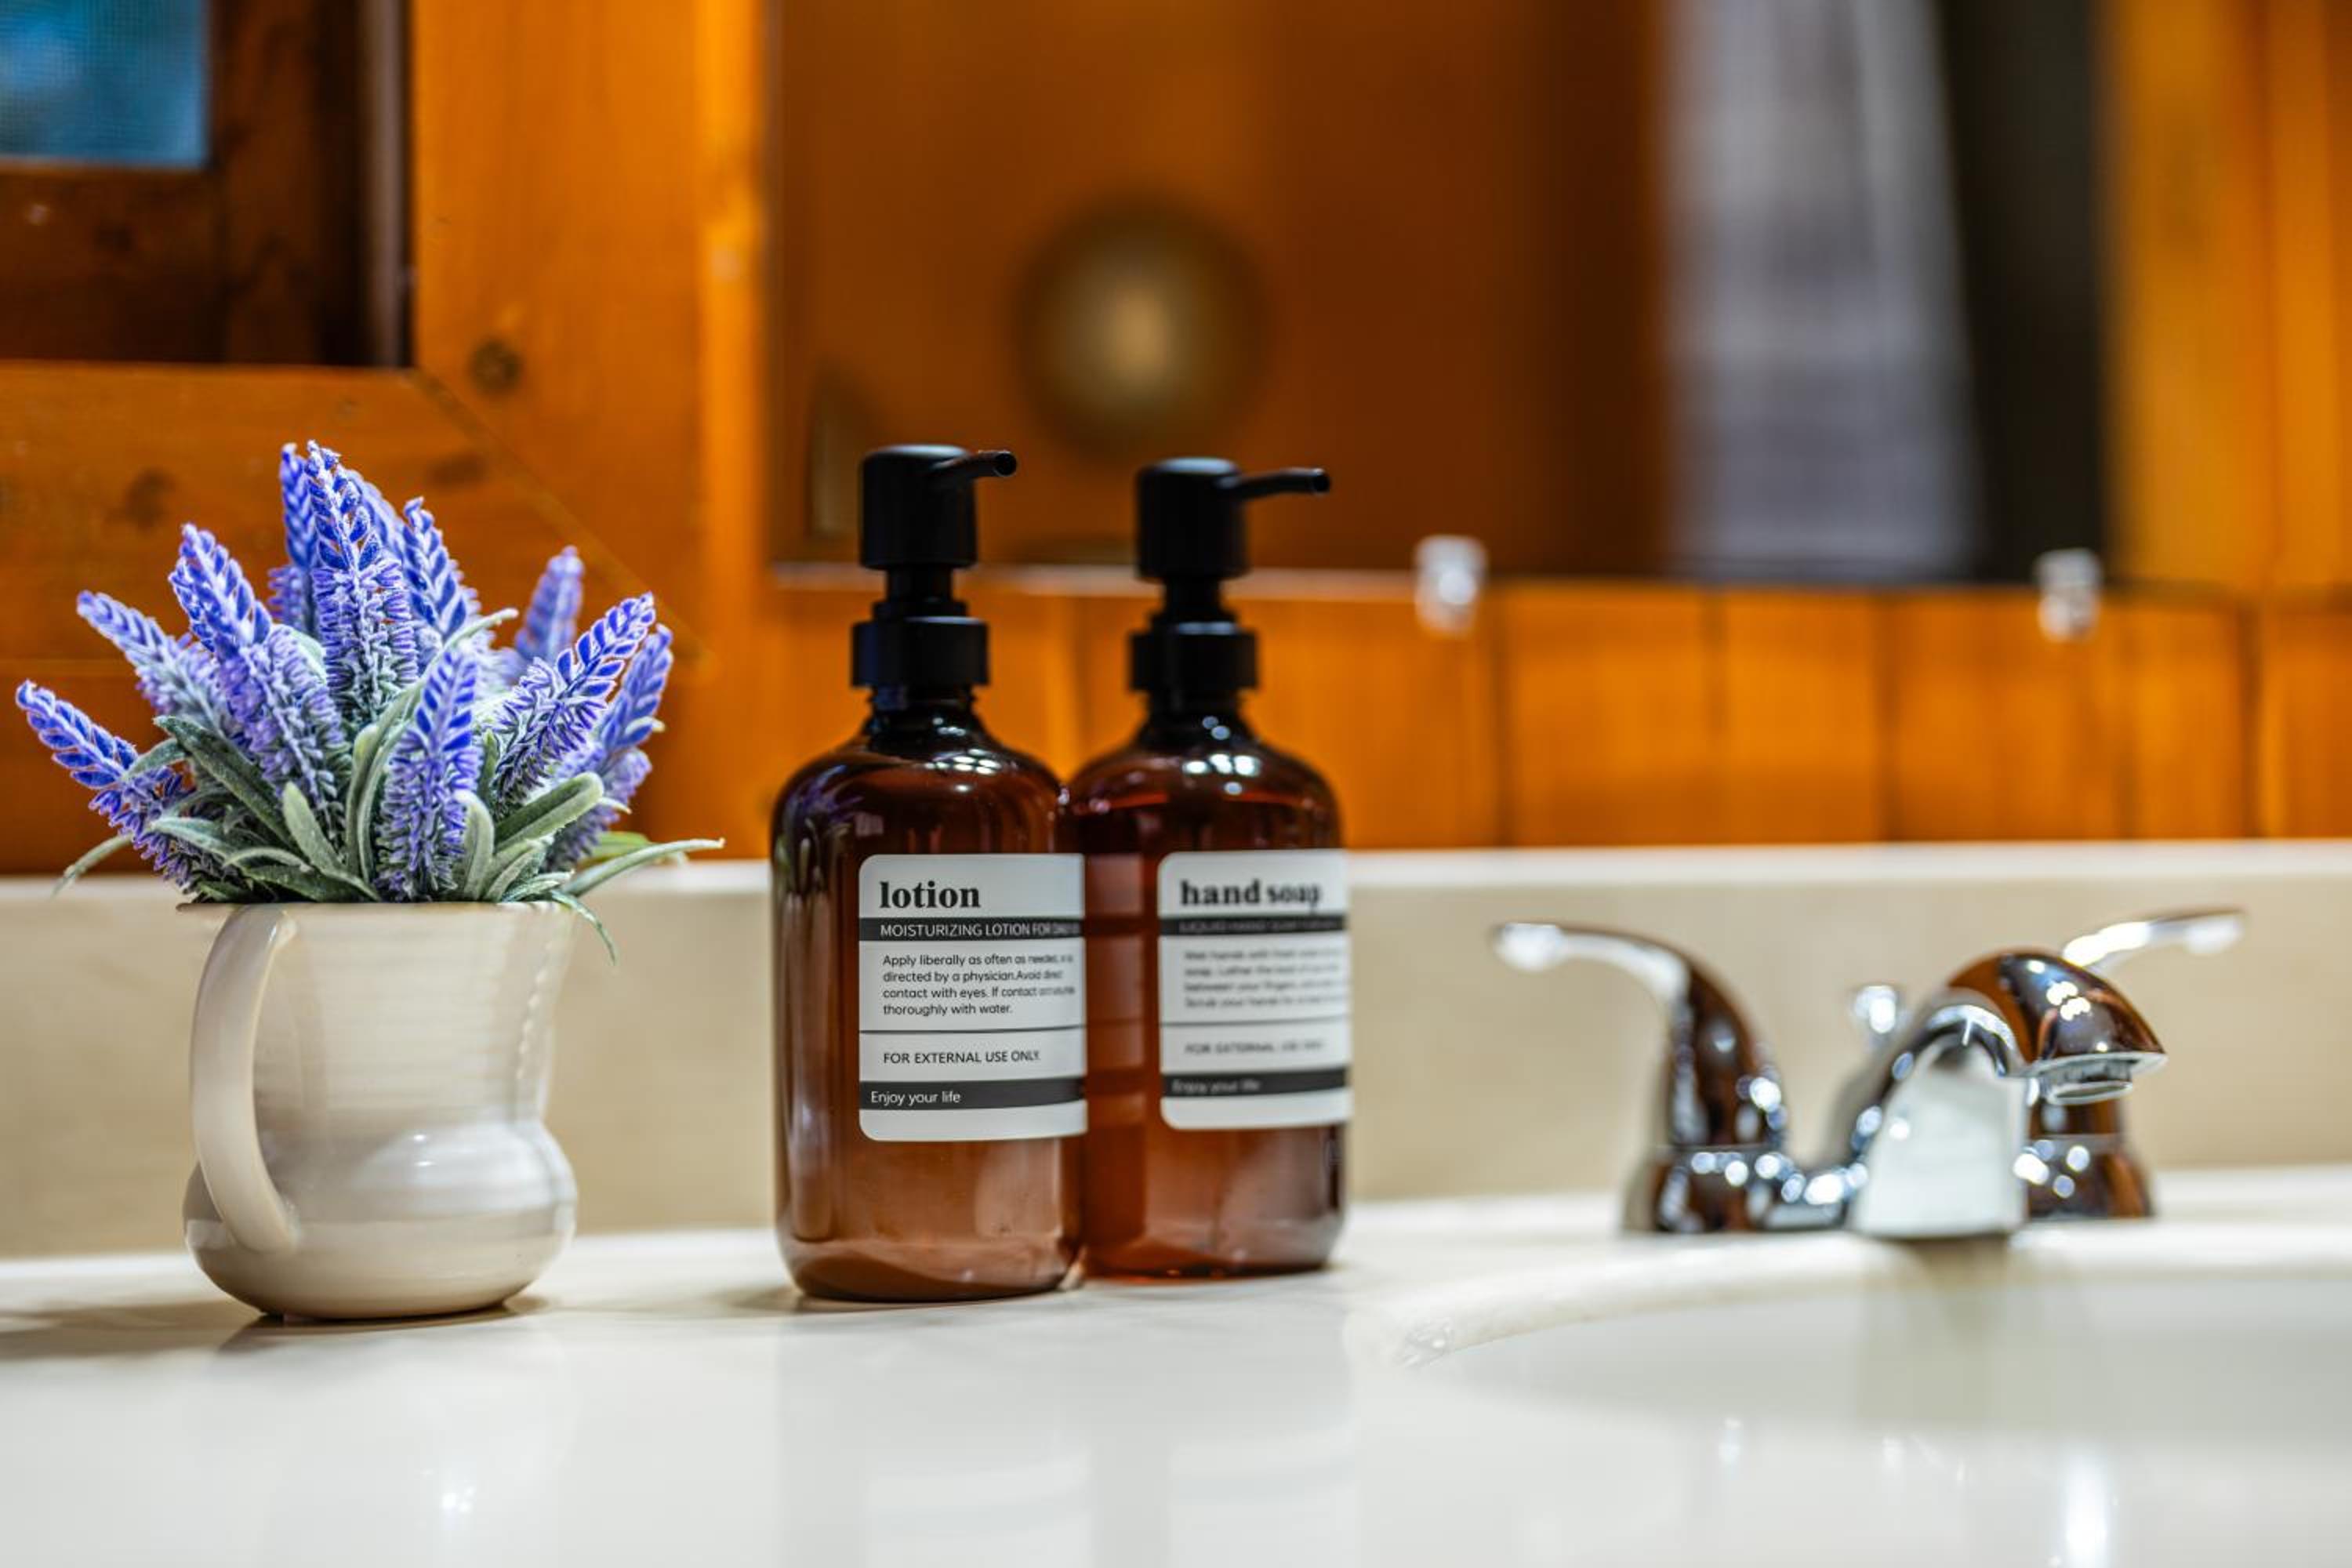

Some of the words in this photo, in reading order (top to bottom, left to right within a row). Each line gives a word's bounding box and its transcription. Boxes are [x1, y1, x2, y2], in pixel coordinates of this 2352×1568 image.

[879, 880, 982, 909] lotion
[1181, 878, 1261, 906] hand
[1267, 884, 1320, 915] soap
[880, 924, 983, 937] MOISTURIZING
[985, 923, 1031, 936] LOTION
[882, 955, 916, 967] Apply
[919, 955, 965, 967] liberally
[985, 954, 1012, 965] often
[883, 971, 932, 982] directed
[934, 971, 949, 985] by
[883, 988, 927, 999] contact
[931, 987, 957, 998] with
[960, 989, 988, 1001] eyes.
[992, 986, 1000, 996] If
[1001, 986, 1037, 997] contact
[884, 1004, 948, 1017] thoroughly
[951, 1004, 976, 1014] with
[979, 1005, 1012, 1014] water.
[884, 1052, 910, 1064] FOR
[915, 1051, 982, 1064] EXTERNAL
[985, 1051, 1007, 1062] USE
[870, 1091, 905, 1106] Enjoy
[908, 1093, 938, 1106] your
[942, 1090, 961, 1103] life
